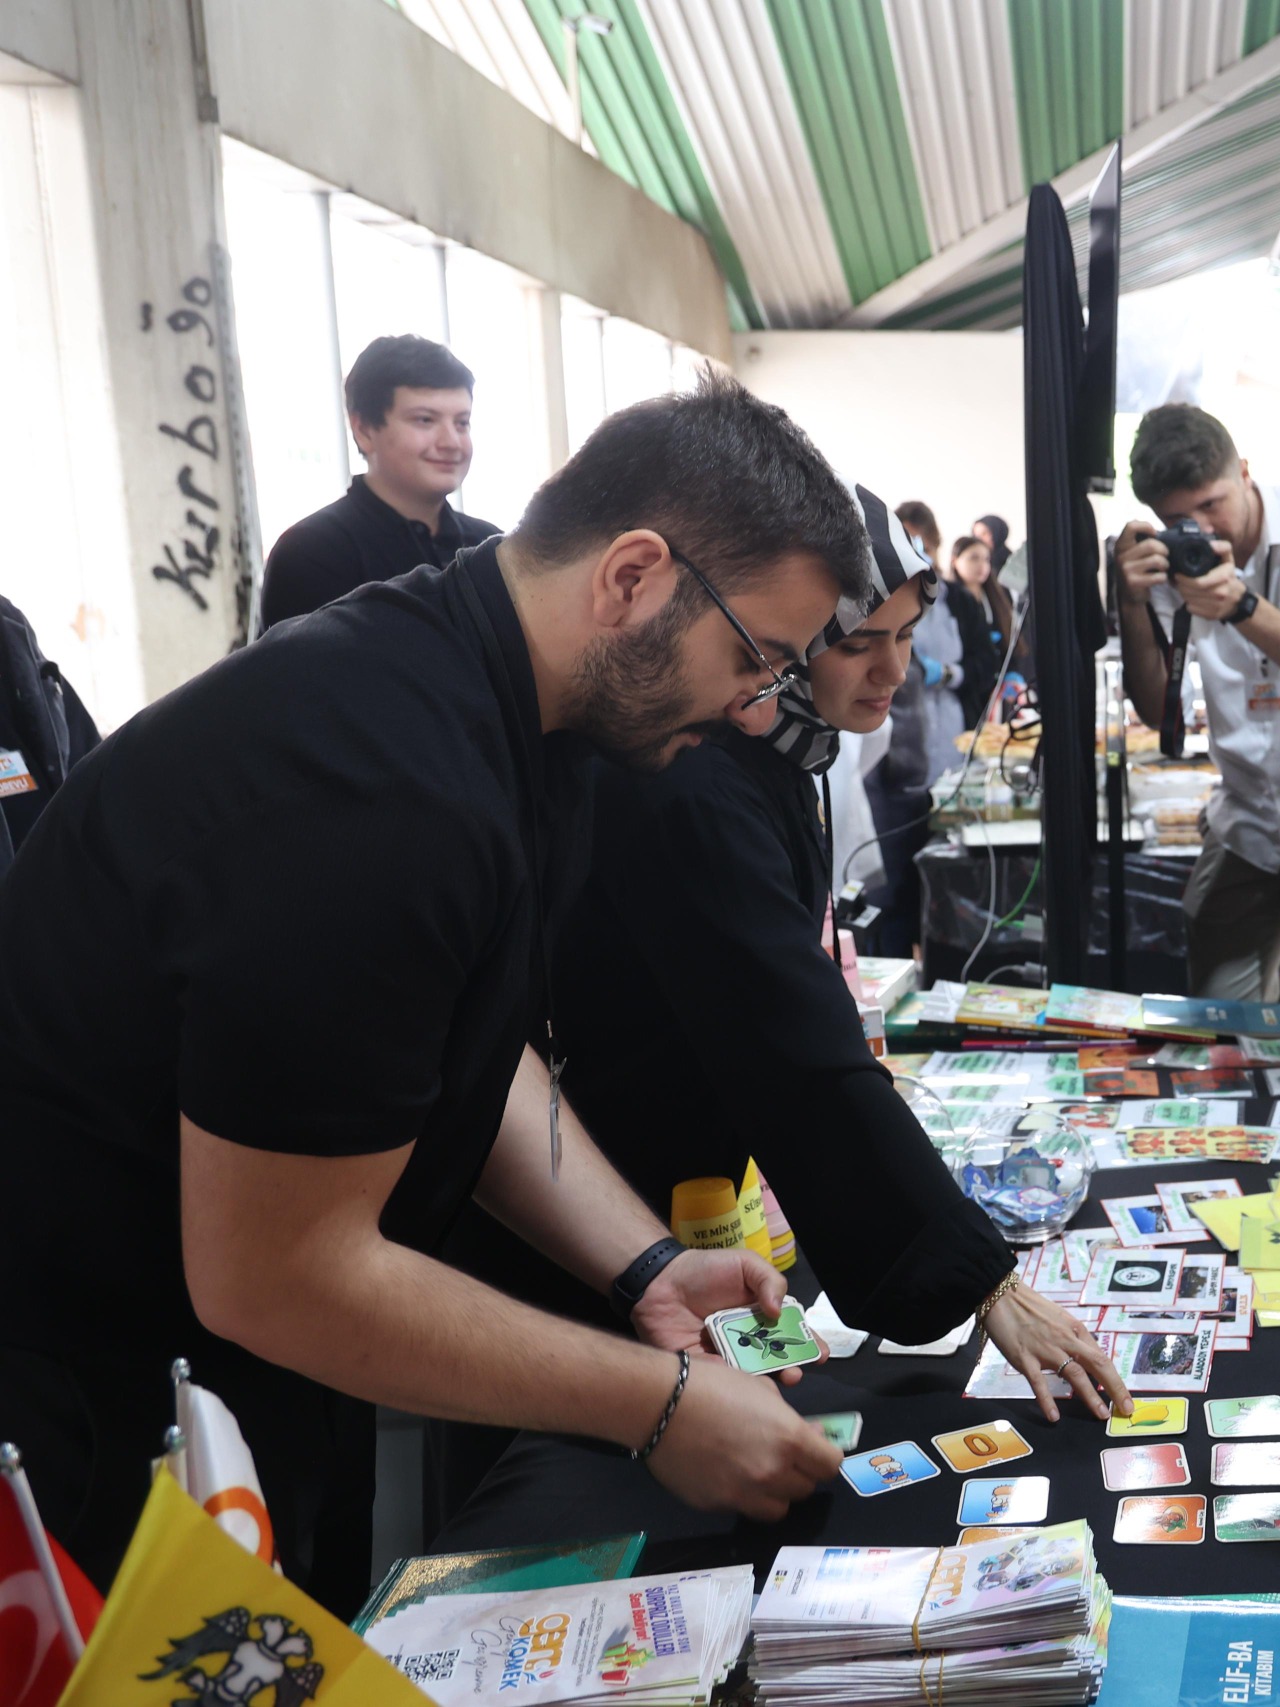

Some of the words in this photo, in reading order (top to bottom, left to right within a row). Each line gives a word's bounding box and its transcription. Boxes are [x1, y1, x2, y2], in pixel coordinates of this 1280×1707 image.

[693, 1230, 710, 1241] VE
[710, 1223, 729, 1238] MİN
[1193, 1350, 1208, 1381] ALAADDİN
[1202, 1329, 1212, 1350] TEPESİ
[629, 1592, 644, 1609] Seni
[645, 1587, 671, 1620] SÜRPRİZ
[632, 1609, 651, 1641] Bekliyor!
[651, 1618, 679, 1656] ÖDÜLLERİ
[674, 1616, 688, 1636] DÖNEM
[499, 1636, 531, 1692] KOMEK
[1219, 1640, 1254, 1704] ELİF-BA
[1252, 1650, 1274, 1697] KİTABIM
